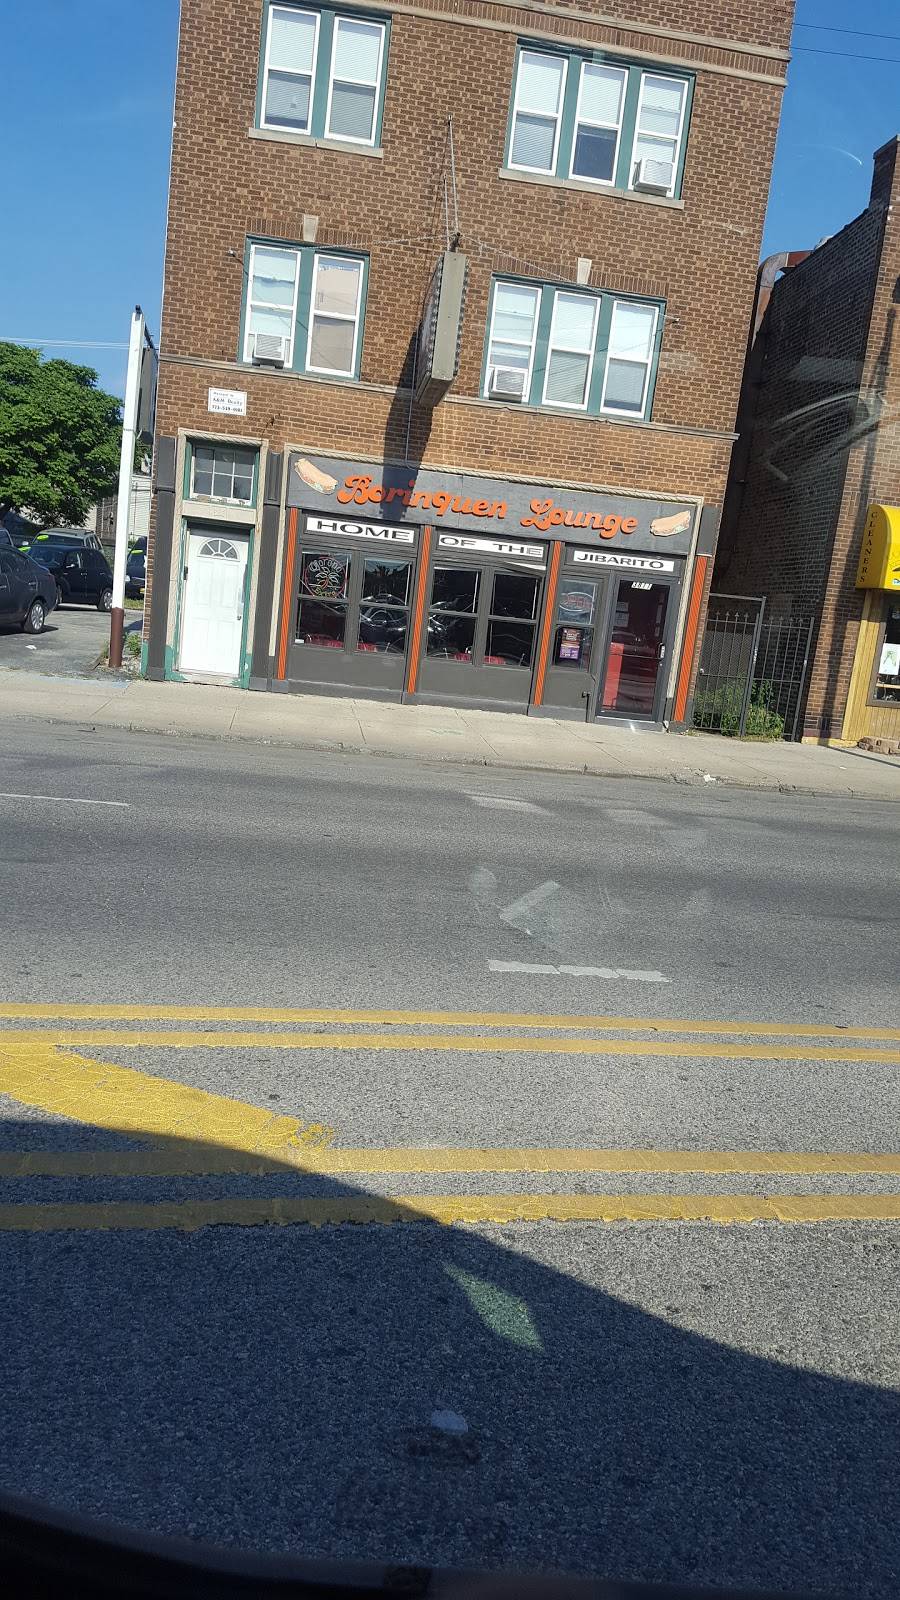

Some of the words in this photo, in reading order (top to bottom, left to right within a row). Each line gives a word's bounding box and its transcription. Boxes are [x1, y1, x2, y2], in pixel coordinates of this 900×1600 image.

[337, 474, 508, 519] Borinquen
[520, 497, 639, 539] Lounge
[317, 520, 410, 540] HOME
[440, 536, 476, 547] OF
[492, 543, 544, 556] THE
[860, 511, 877, 583] CLEANERS
[308, 558, 343, 573] Corona
[577, 553, 665, 569] JIBARITO
